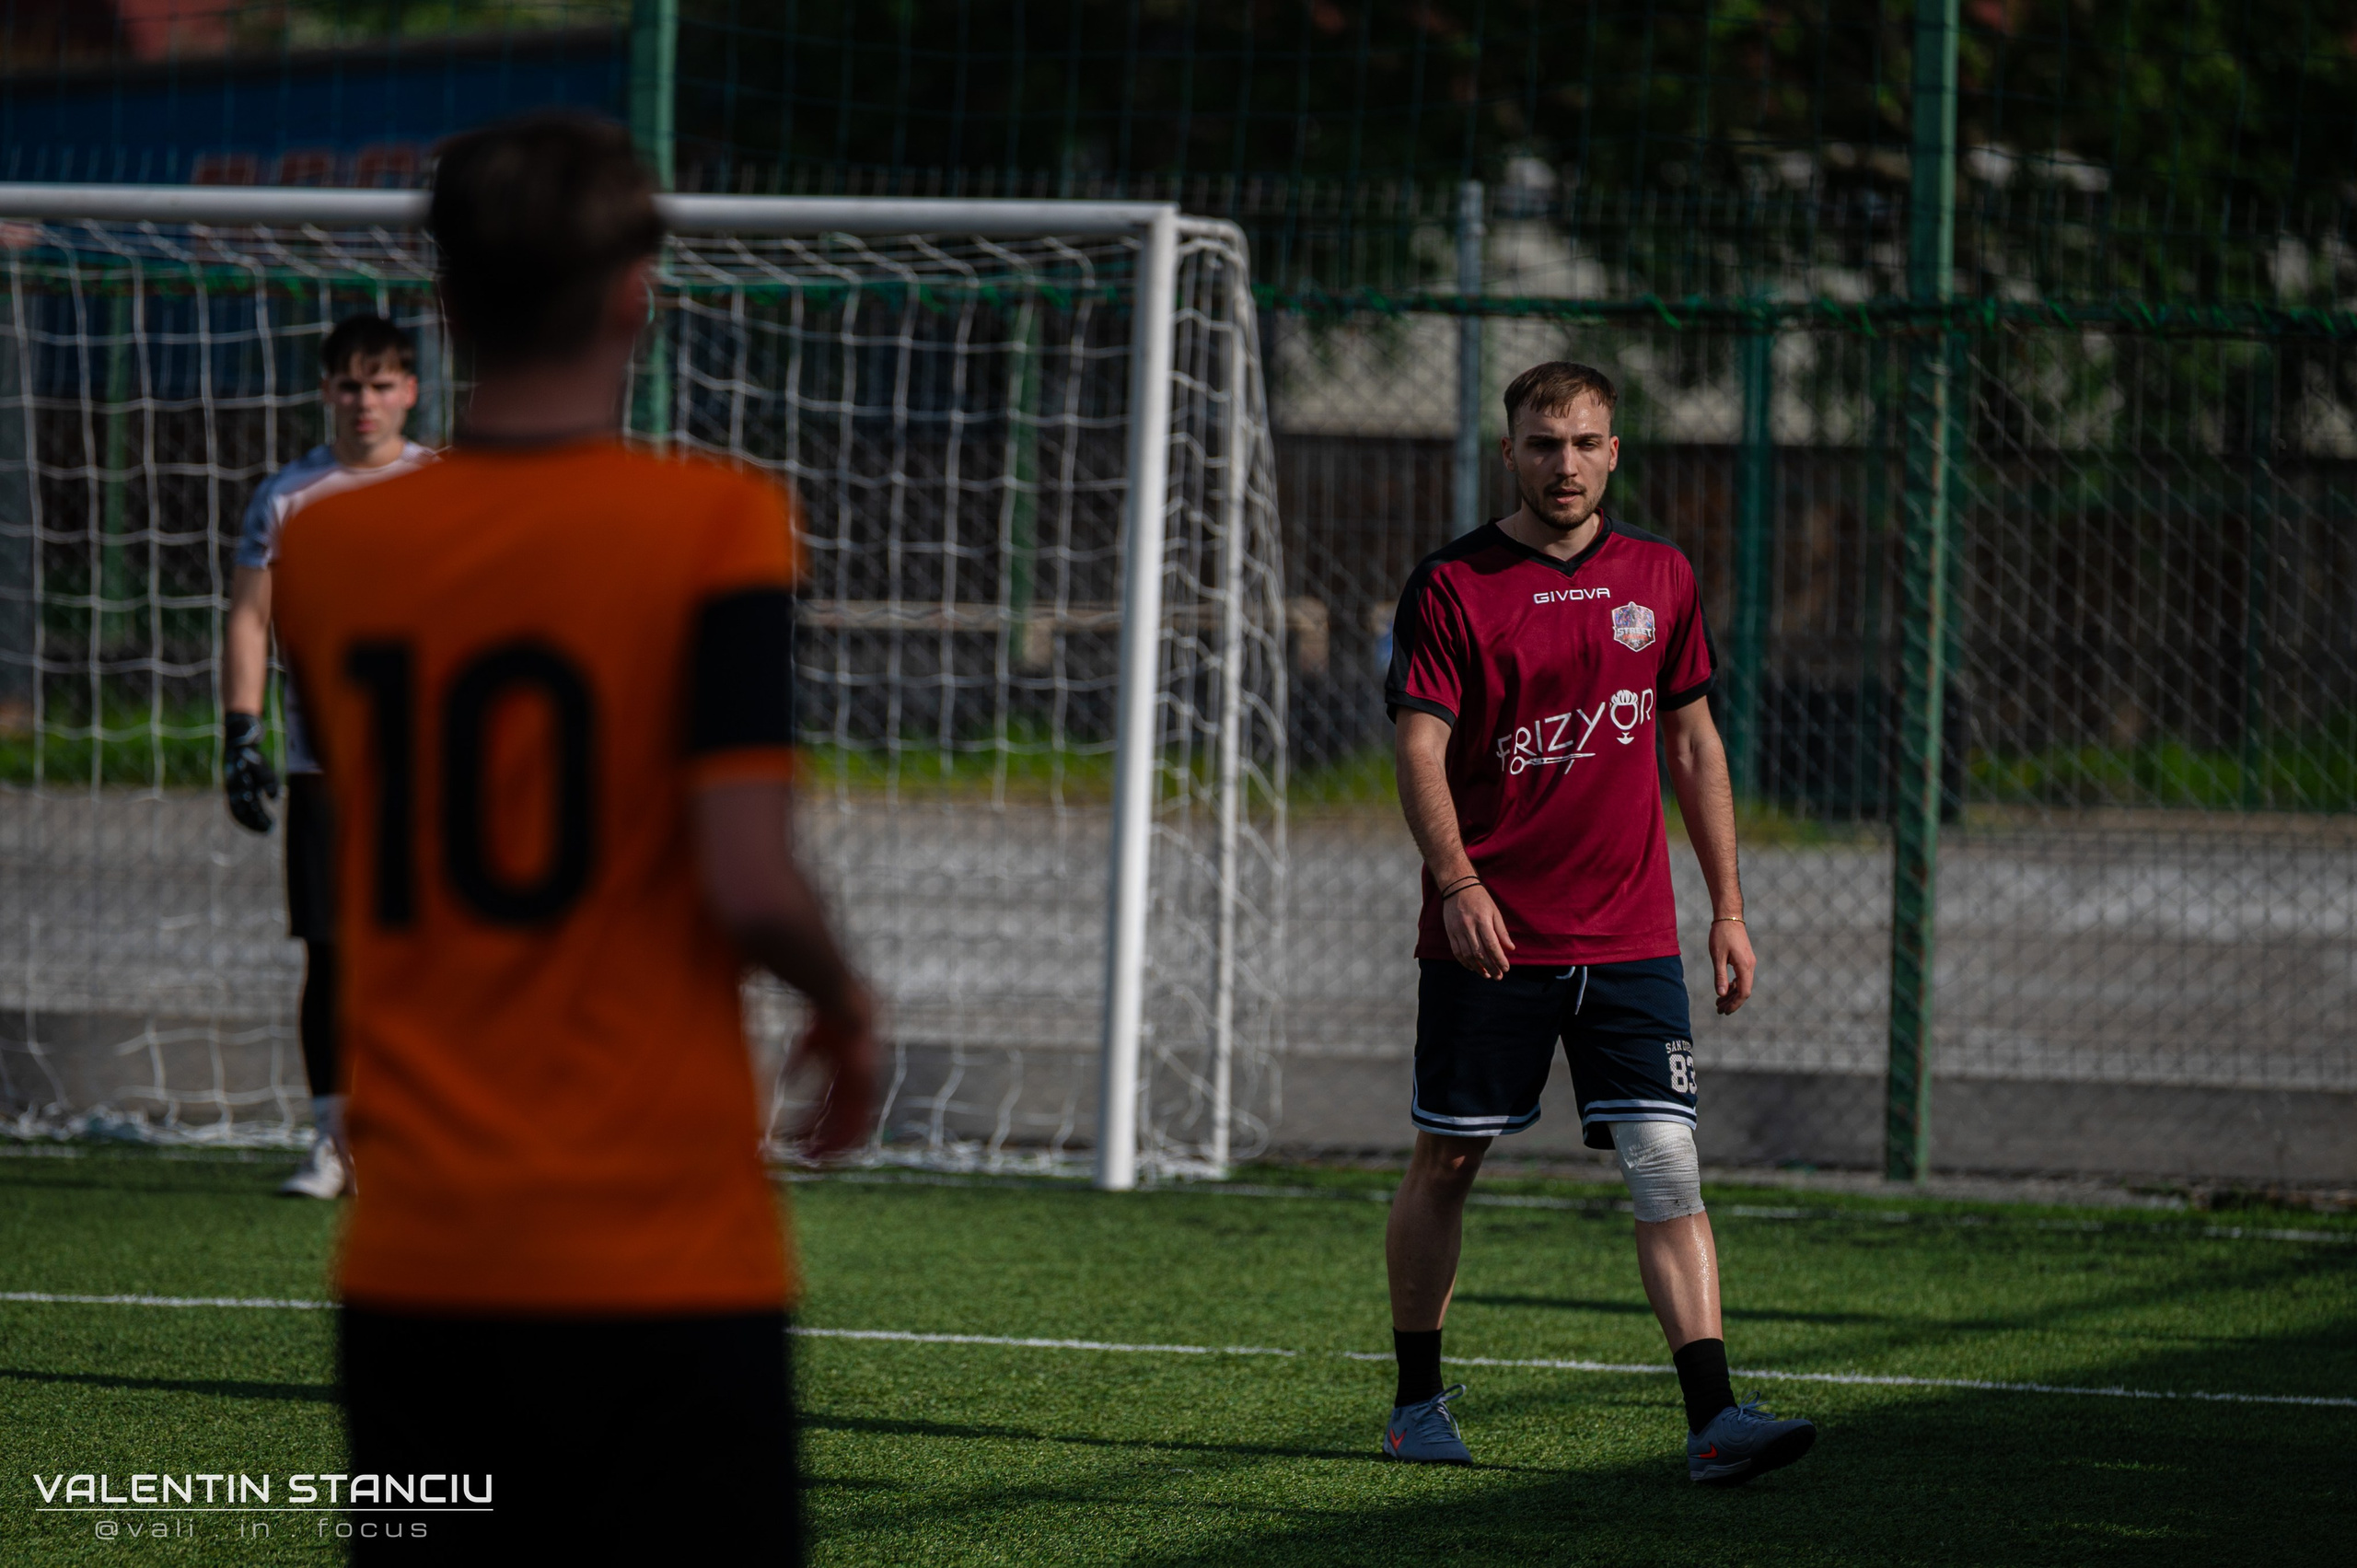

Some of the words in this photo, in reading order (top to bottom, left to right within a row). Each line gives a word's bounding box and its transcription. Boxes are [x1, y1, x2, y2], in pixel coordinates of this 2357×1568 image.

[1534, 587, 1611, 604] GIVOVA
[1617, 627, 1653, 638] STREET
[343, 639, 597, 928] 10
[1666, 1040, 1682, 1054] SAN
[1668, 1054, 1697, 1094] 83
